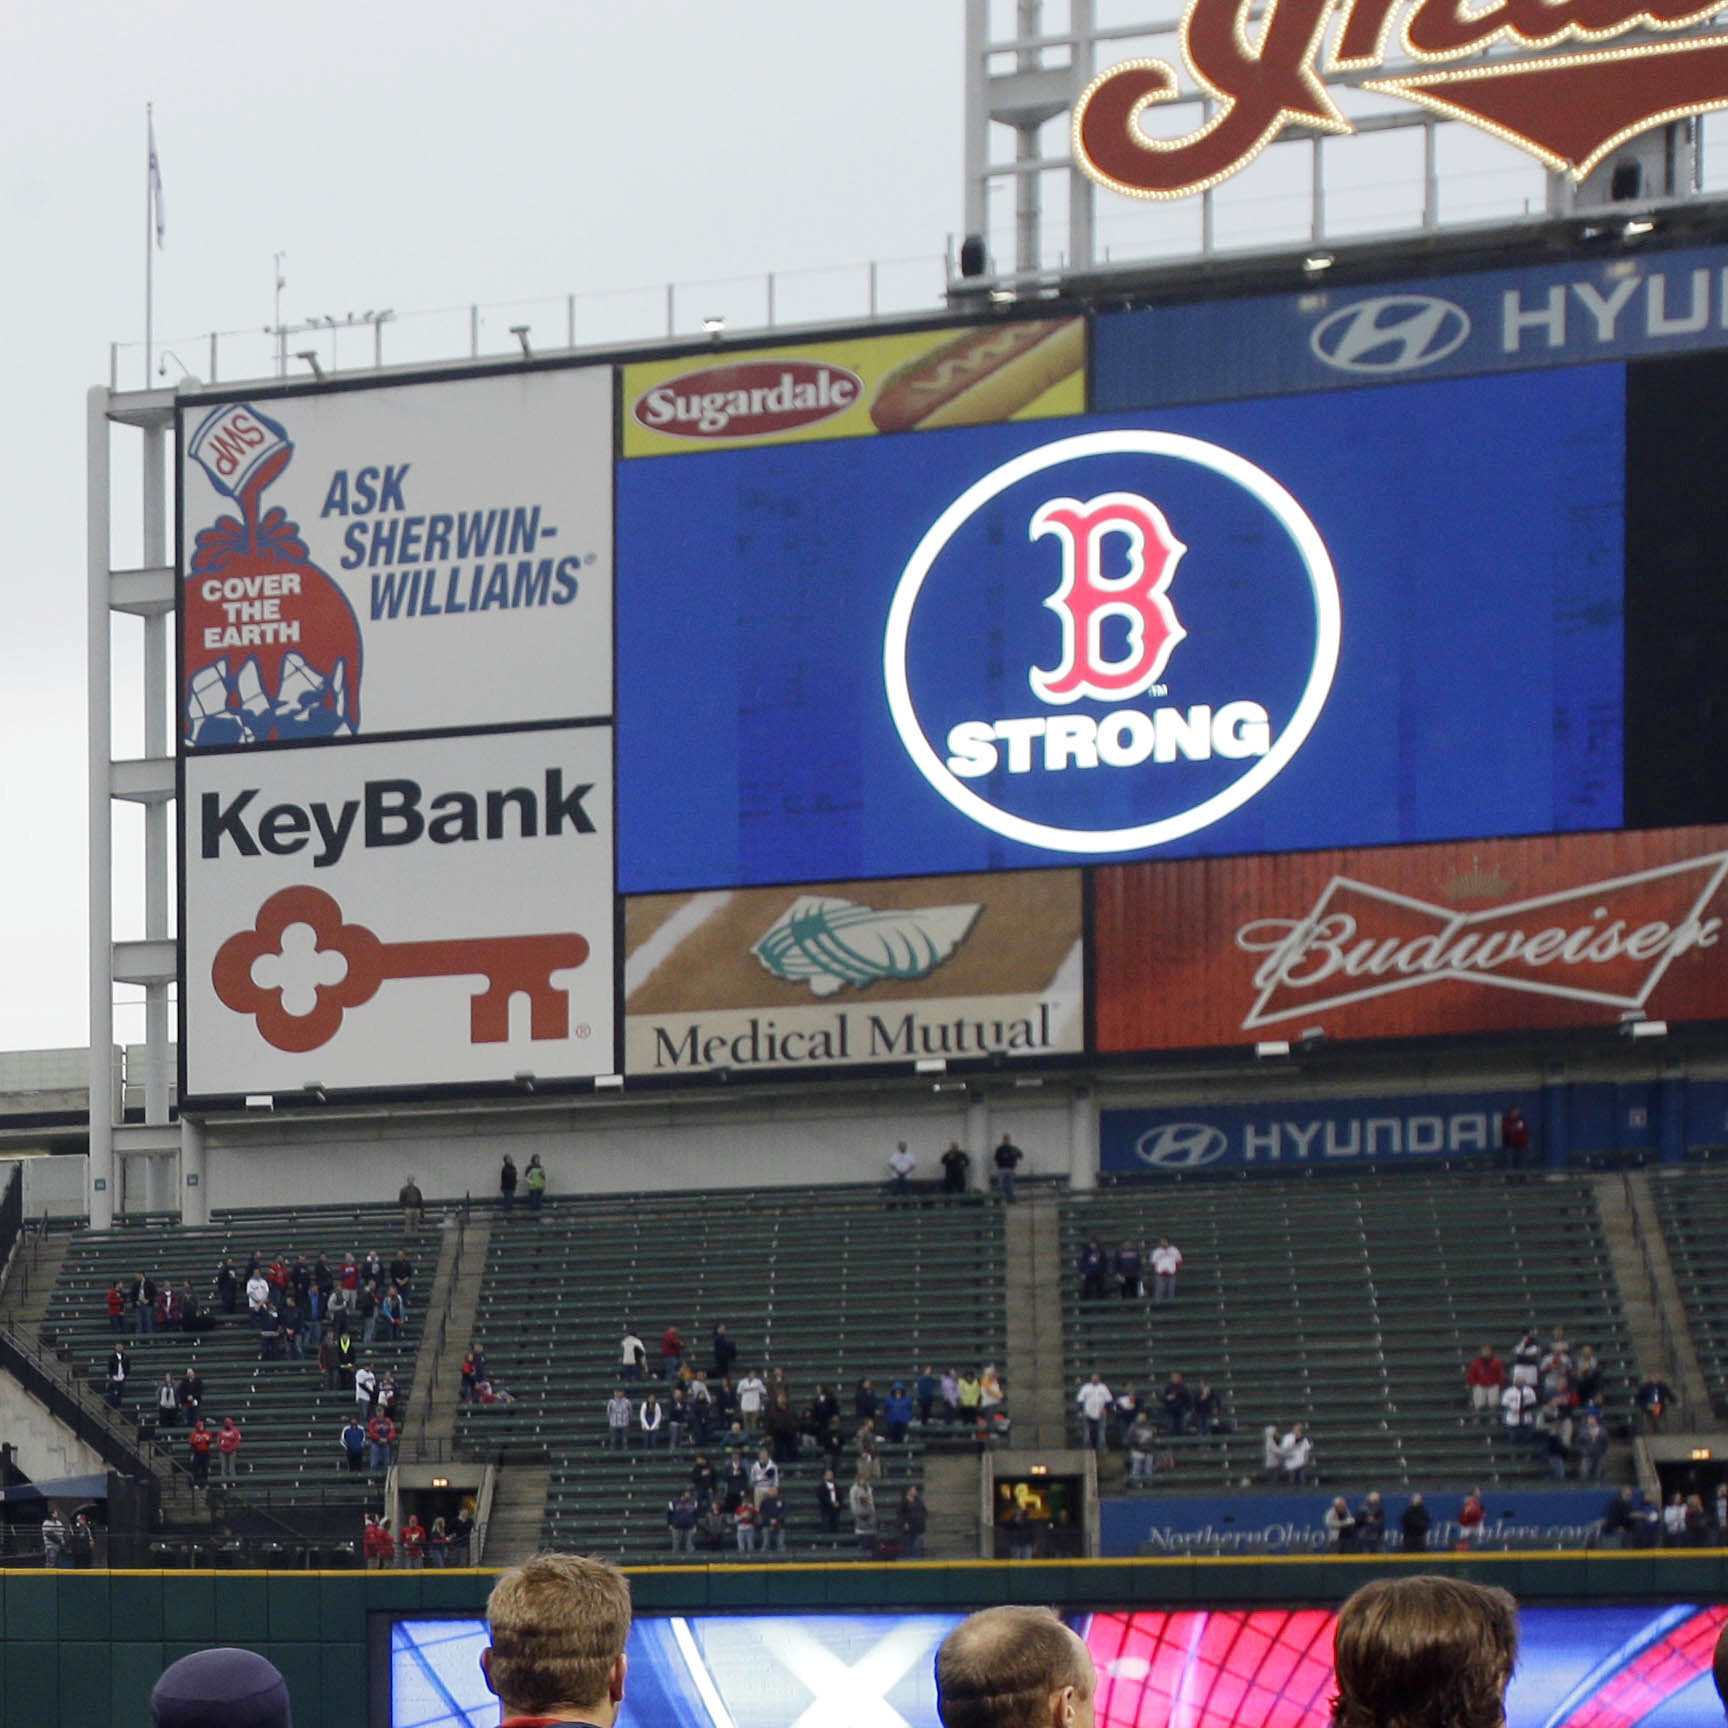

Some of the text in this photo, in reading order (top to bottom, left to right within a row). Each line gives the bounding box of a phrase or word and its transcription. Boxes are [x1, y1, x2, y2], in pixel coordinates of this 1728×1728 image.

[1504, 267, 1728, 353] HYU
[644, 371, 856, 432] Sugardale
[320, 463, 412, 519] ASK
[340, 505, 558, 571] SHERWIN-
[201, 573, 301, 602] COVER
[222, 600, 281, 624] THE
[369, 555, 581, 622] WILLIAMS
[204, 619, 301, 650] EARTH
[946, 700, 1271, 778] STRONG
[200, 768, 598, 868] KeyBank
[1236, 905, 1724, 990] Budweiser
[652, 1002, 1056, 1070] Medical Mutual
[1245, 1111, 1502, 1161] HYUNDAI
